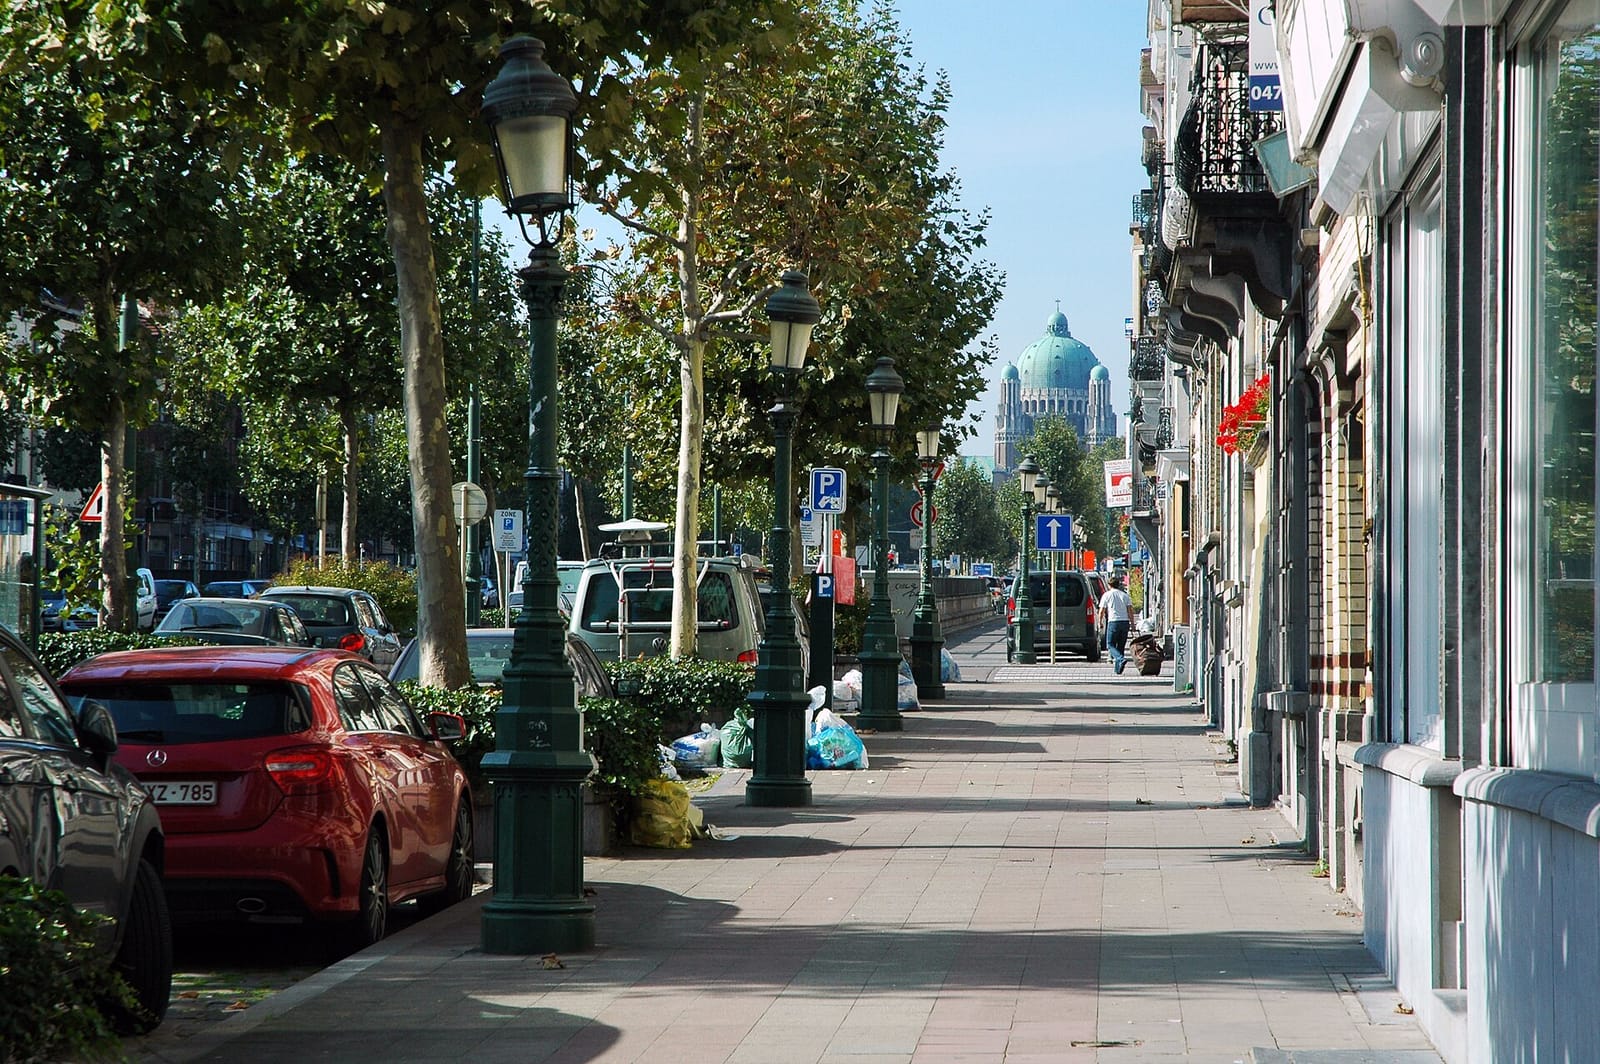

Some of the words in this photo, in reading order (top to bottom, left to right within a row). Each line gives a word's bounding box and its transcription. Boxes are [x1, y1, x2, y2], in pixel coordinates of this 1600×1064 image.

[1251, 85, 1282, 101] 047
[819, 473, 835, 495] P
[818, 576, 831, 594] P
[143, 784, 213, 801] XZ-785
